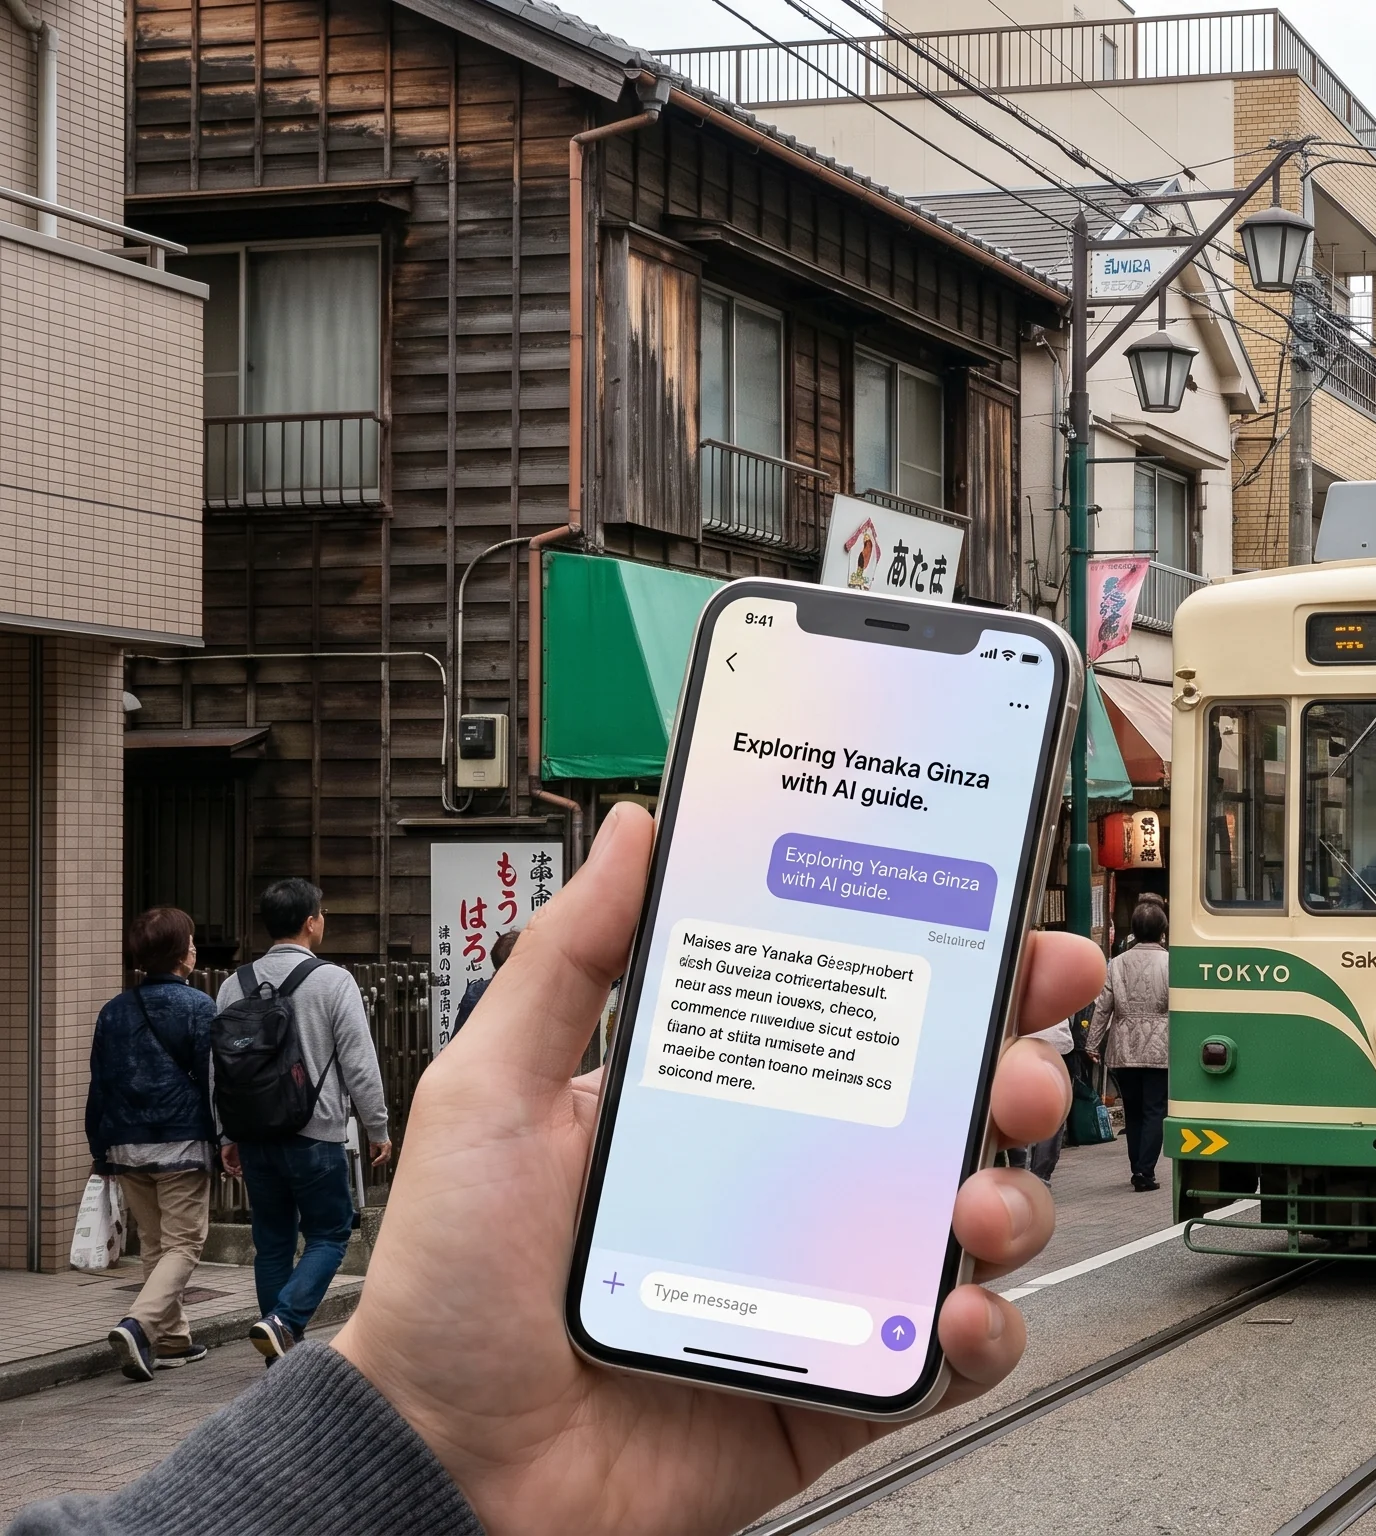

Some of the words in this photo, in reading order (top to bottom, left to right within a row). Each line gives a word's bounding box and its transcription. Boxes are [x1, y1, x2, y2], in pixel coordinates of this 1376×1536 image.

[745, 612, 774, 628] 9:41
[733, 732, 836, 770] Exploring
[843, 748, 921, 779] Yanaka
[927, 762, 990, 790] Ginza
[781, 773, 828, 796] with
[832, 779, 856, 800] AI
[860, 786, 929, 812] guide.
[782, 871, 815, 889] with
[819, 876, 837, 892] AI
[840, 881, 891, 900] guide.
[785, 847, 863, 876] Exploring
[870, 859, 928, 883] Yanaka
[933, 870, 980, 891] Ginza
[683, 933, 732, 952] Maises
[735, 943, 757, 956] are
[762, 945, 813, 966] Yanaka
[716, 960, 771, 981] Guveiza
[1199, 963, 1290, 983] TOKYO
[708, 984, 732, 997] ass
[736, 987, 772, 1003] meun
[830, 1002, 877, 1021] checo,
[671, 1000, 746, 1021] commence
[818, 1022, 853, 1039] sicut
[856, 1029, 900, 1046] estoio
[709, 1027, 724, 1040] at
[828, 1048, 856, 1062] and
[658, 1064, 713, 1083] soicond
[716, 1074, 756, 1090] mere.
[662, 1043, 715, 1061] maeibe
[719, 1052, 766, 1069] conten
[866, 1076, 892, 1091] scs
[654, 1283, 689, 1303] Type
[692, 1291, 758, 1316] message
